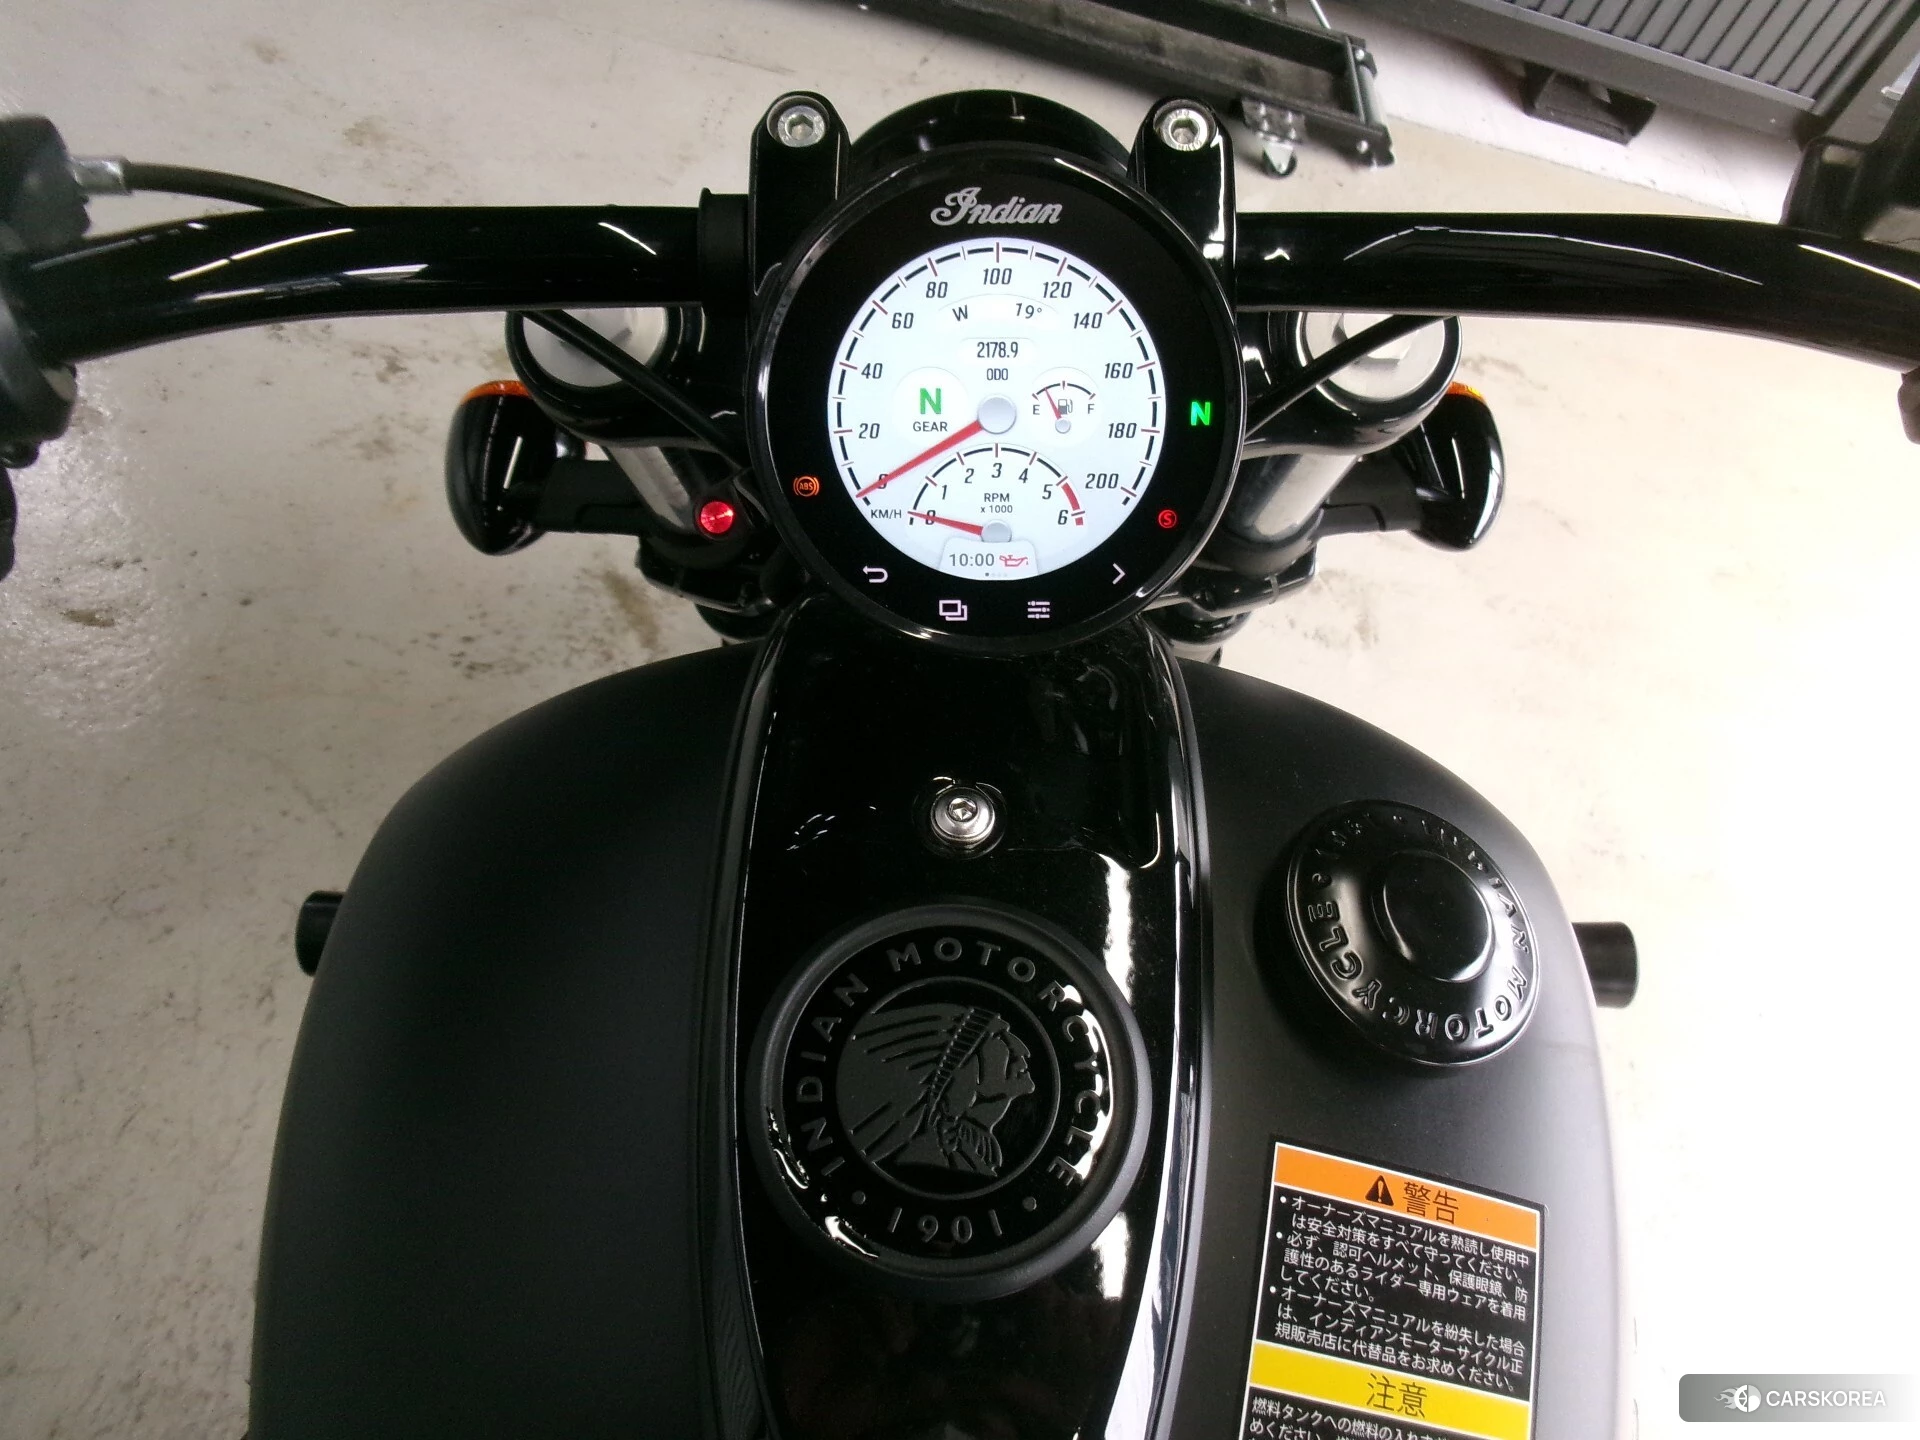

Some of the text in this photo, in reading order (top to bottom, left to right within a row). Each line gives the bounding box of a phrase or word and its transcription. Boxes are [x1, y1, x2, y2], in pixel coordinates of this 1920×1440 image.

[930, 187, 1063, 226] Indian
[983, 268, 1012, 285] 100
[925, 281, 948, 299] 80
[1042, 281, 1072, 299] 120
[891, 312, 914, 329] 60
[952, 305, 968, 321] W
[1073, 312, 1102, 329] 140
[976, 341, 1018, 358] 2178.9
[861, 363, 883, 379] 40
[1104, 363, 1133, 380] 160
[919, 387, 942, 415] N
[1033, 404, 1040, 415] E
[1088, 404, 1095, 415] F
[1190, 401, 1211, 426] N
[858, 423, 880, 439] 20
[912, 421, 948, 432] GEAR
[1107, 422, 1137, 439] 180
[964, 468, 975, 484] 2
[991, 462, 1002, 478] 3
[1018, 468, 1029, 484] 4
[1085, 473, 1119, 489] 200
[941, 484, 948, 500] 1
[984, 493, 1010, 502] RPM
[1042, 484, 1053, 500] 5
[870, 509, 902, 519] KM/H
[989, 505, 1013, 513] 1000
[1057, 509, 1069, 525] 6
[949, 553, 995, 567] 10:00
[797, 937, 1101, 1187] INDIAN MOTORCYCLE
[1402, 1181, 1460, 1225] 警告
[887, 1207, 1003, 1243] 1901
[1280, 1265, 1374, 1302] してください。
[1366, 1372, 1428, 1418] 注意
[1251, 1396, 1447, 1440] 燃料タンクへの燃料の入れ
